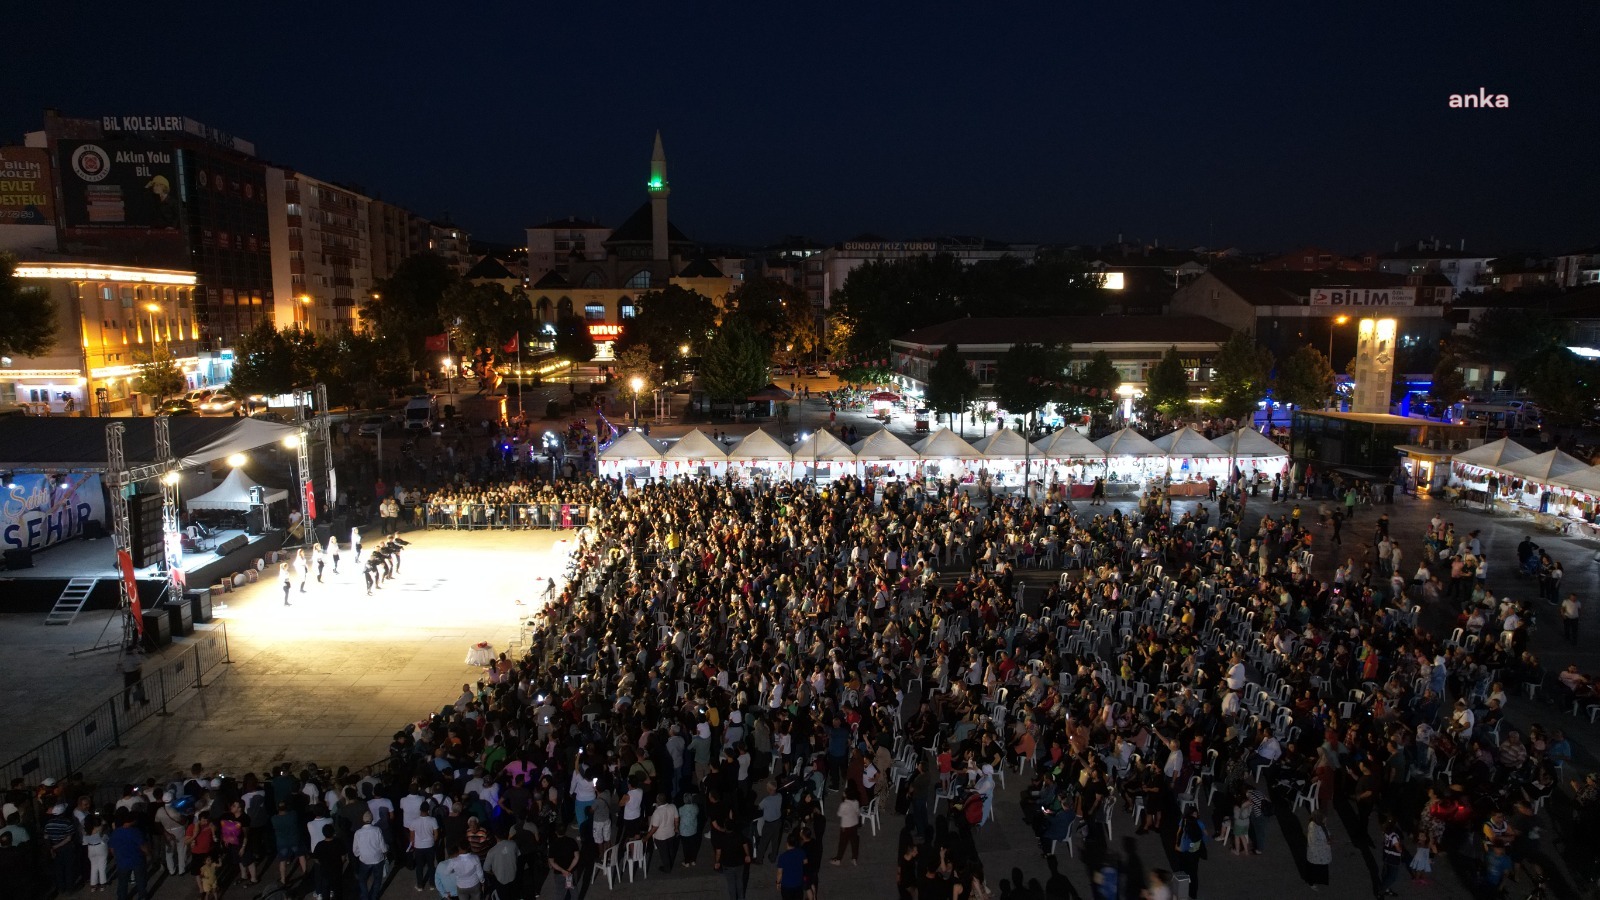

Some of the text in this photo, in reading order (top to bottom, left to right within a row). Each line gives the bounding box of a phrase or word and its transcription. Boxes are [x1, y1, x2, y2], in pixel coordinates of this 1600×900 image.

[146, 151, 171, 164] Yolu
[5, 161, 41, 170] BİLİM
[135, 164, 152, 177] BİL
[0, 181, 35, 192] EVLET
[903, 242, 936, 250] YURDU
[1331, 289, 1389, 306] BİLİM
